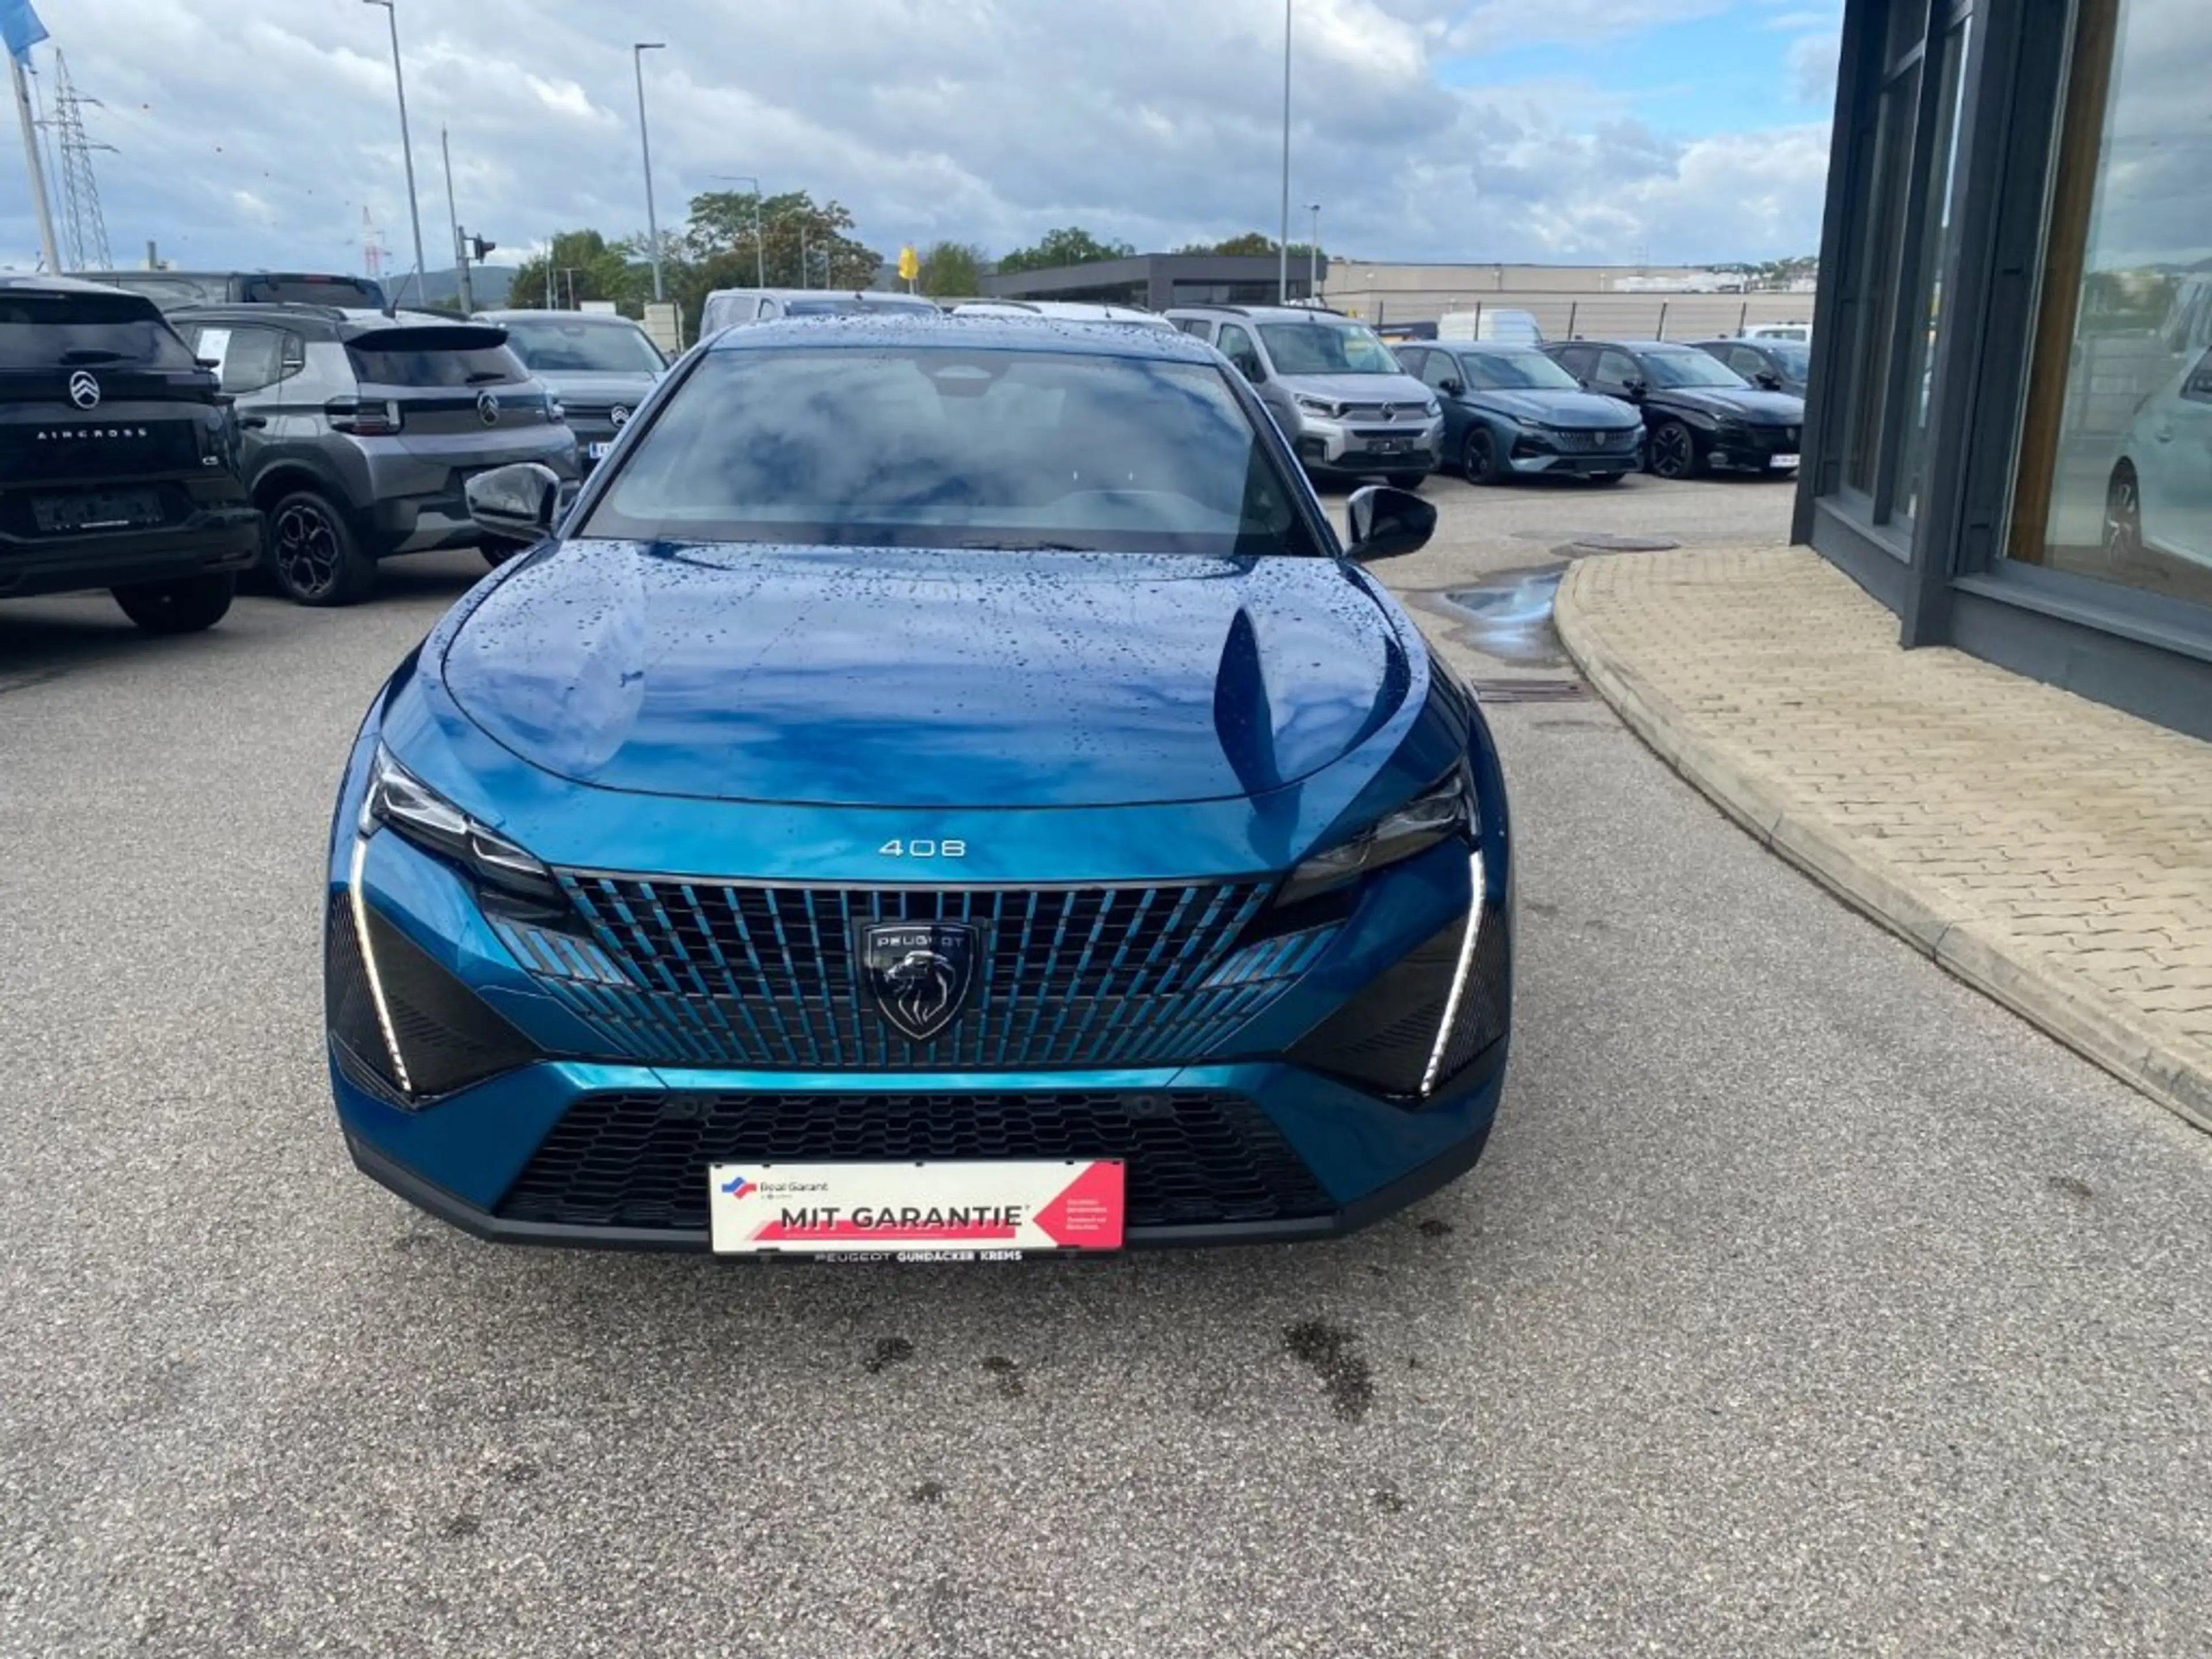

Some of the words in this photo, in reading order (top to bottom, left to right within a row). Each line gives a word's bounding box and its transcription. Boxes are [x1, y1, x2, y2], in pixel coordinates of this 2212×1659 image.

[37, 428, 147, 440] AIRCROSS
[878, 839, 966, 857] 408
[789, 1181, 828, 1191] Garant
[781, 1207, 840, 1228] MIT
[814, 1252, 891, 1263] PEUGEOT
[896, 1251, 975, 1262] GUNDACKER
[980, 1250, 1022, 1261] KREMS
